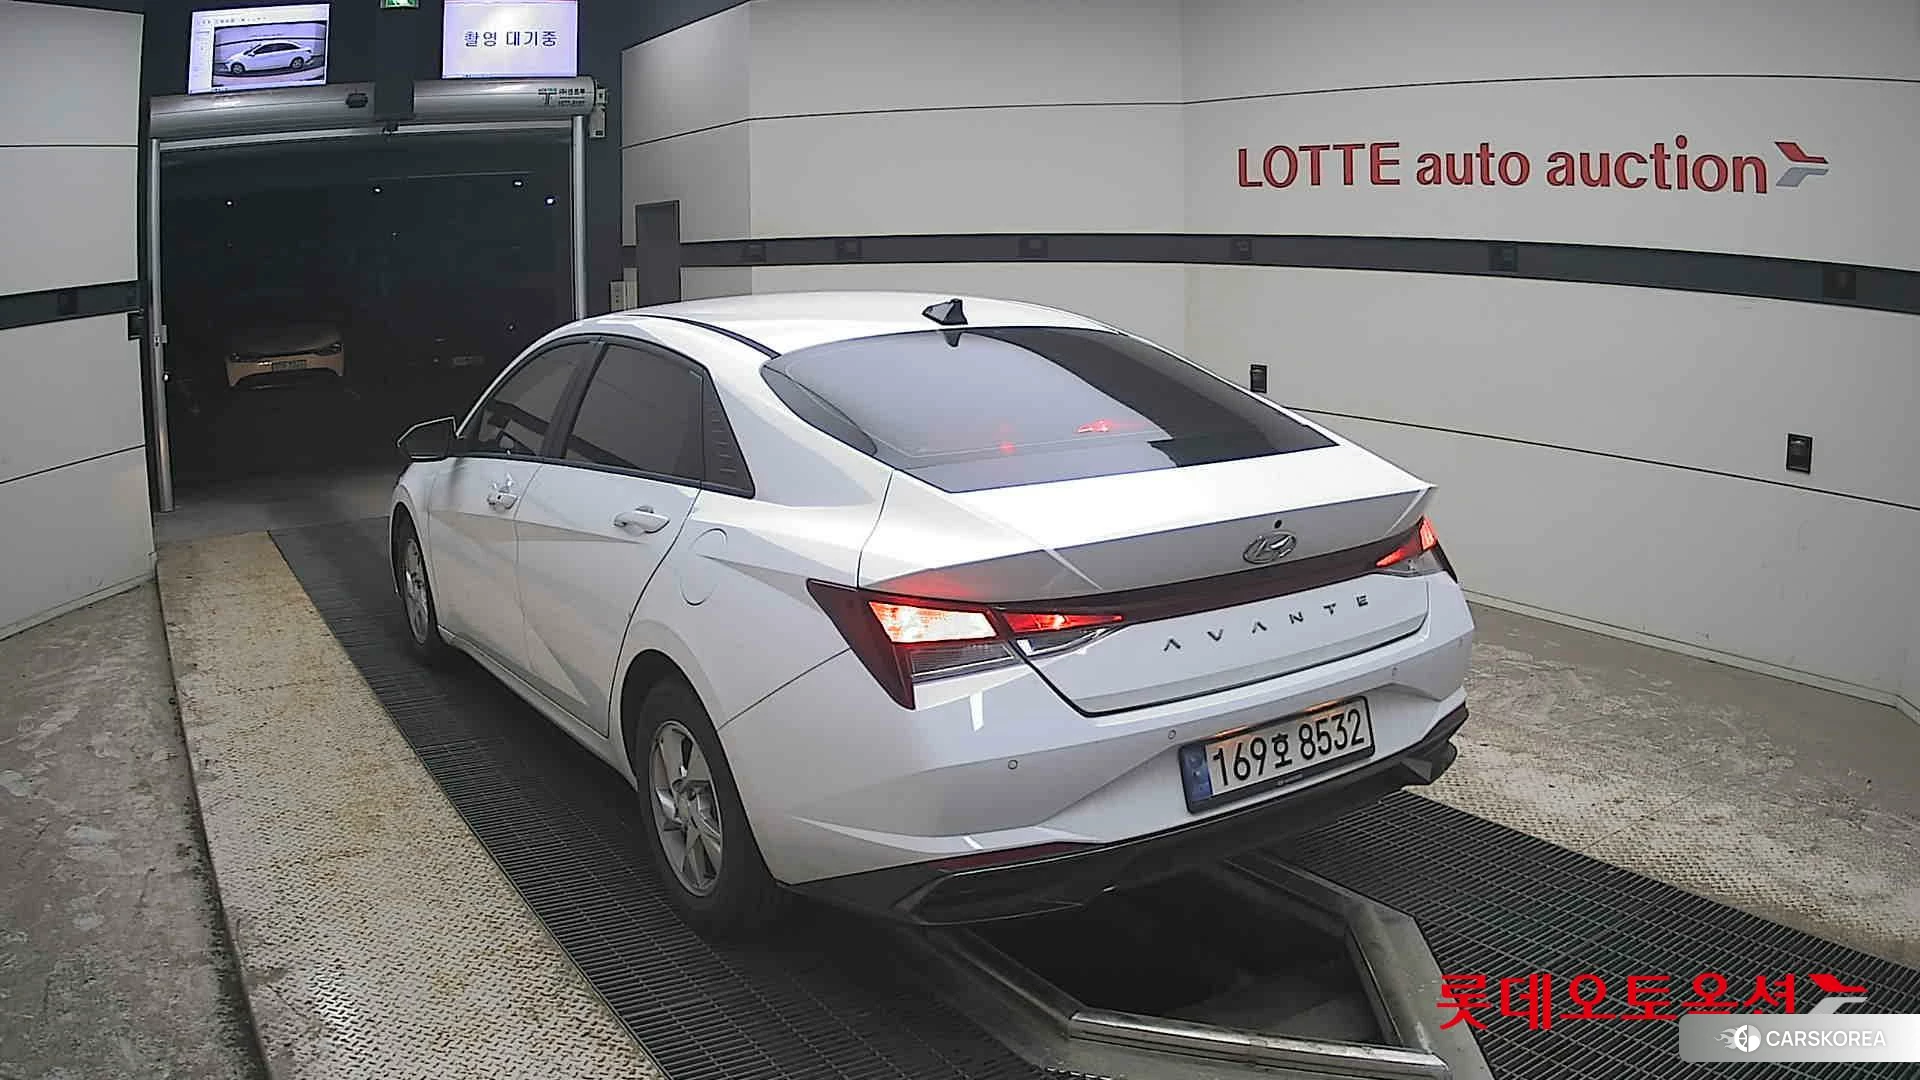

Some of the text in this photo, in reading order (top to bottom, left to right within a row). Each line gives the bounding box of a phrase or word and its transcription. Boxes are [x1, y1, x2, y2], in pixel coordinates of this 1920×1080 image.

[464, 31, 557, 47] 촬영 대기중
[1238, 135, 1767, 194] LOTTE auto auction
[1163, 594, 1369, 652] AVANTE
[1212, 708, 1365, 786] 169호 8532
